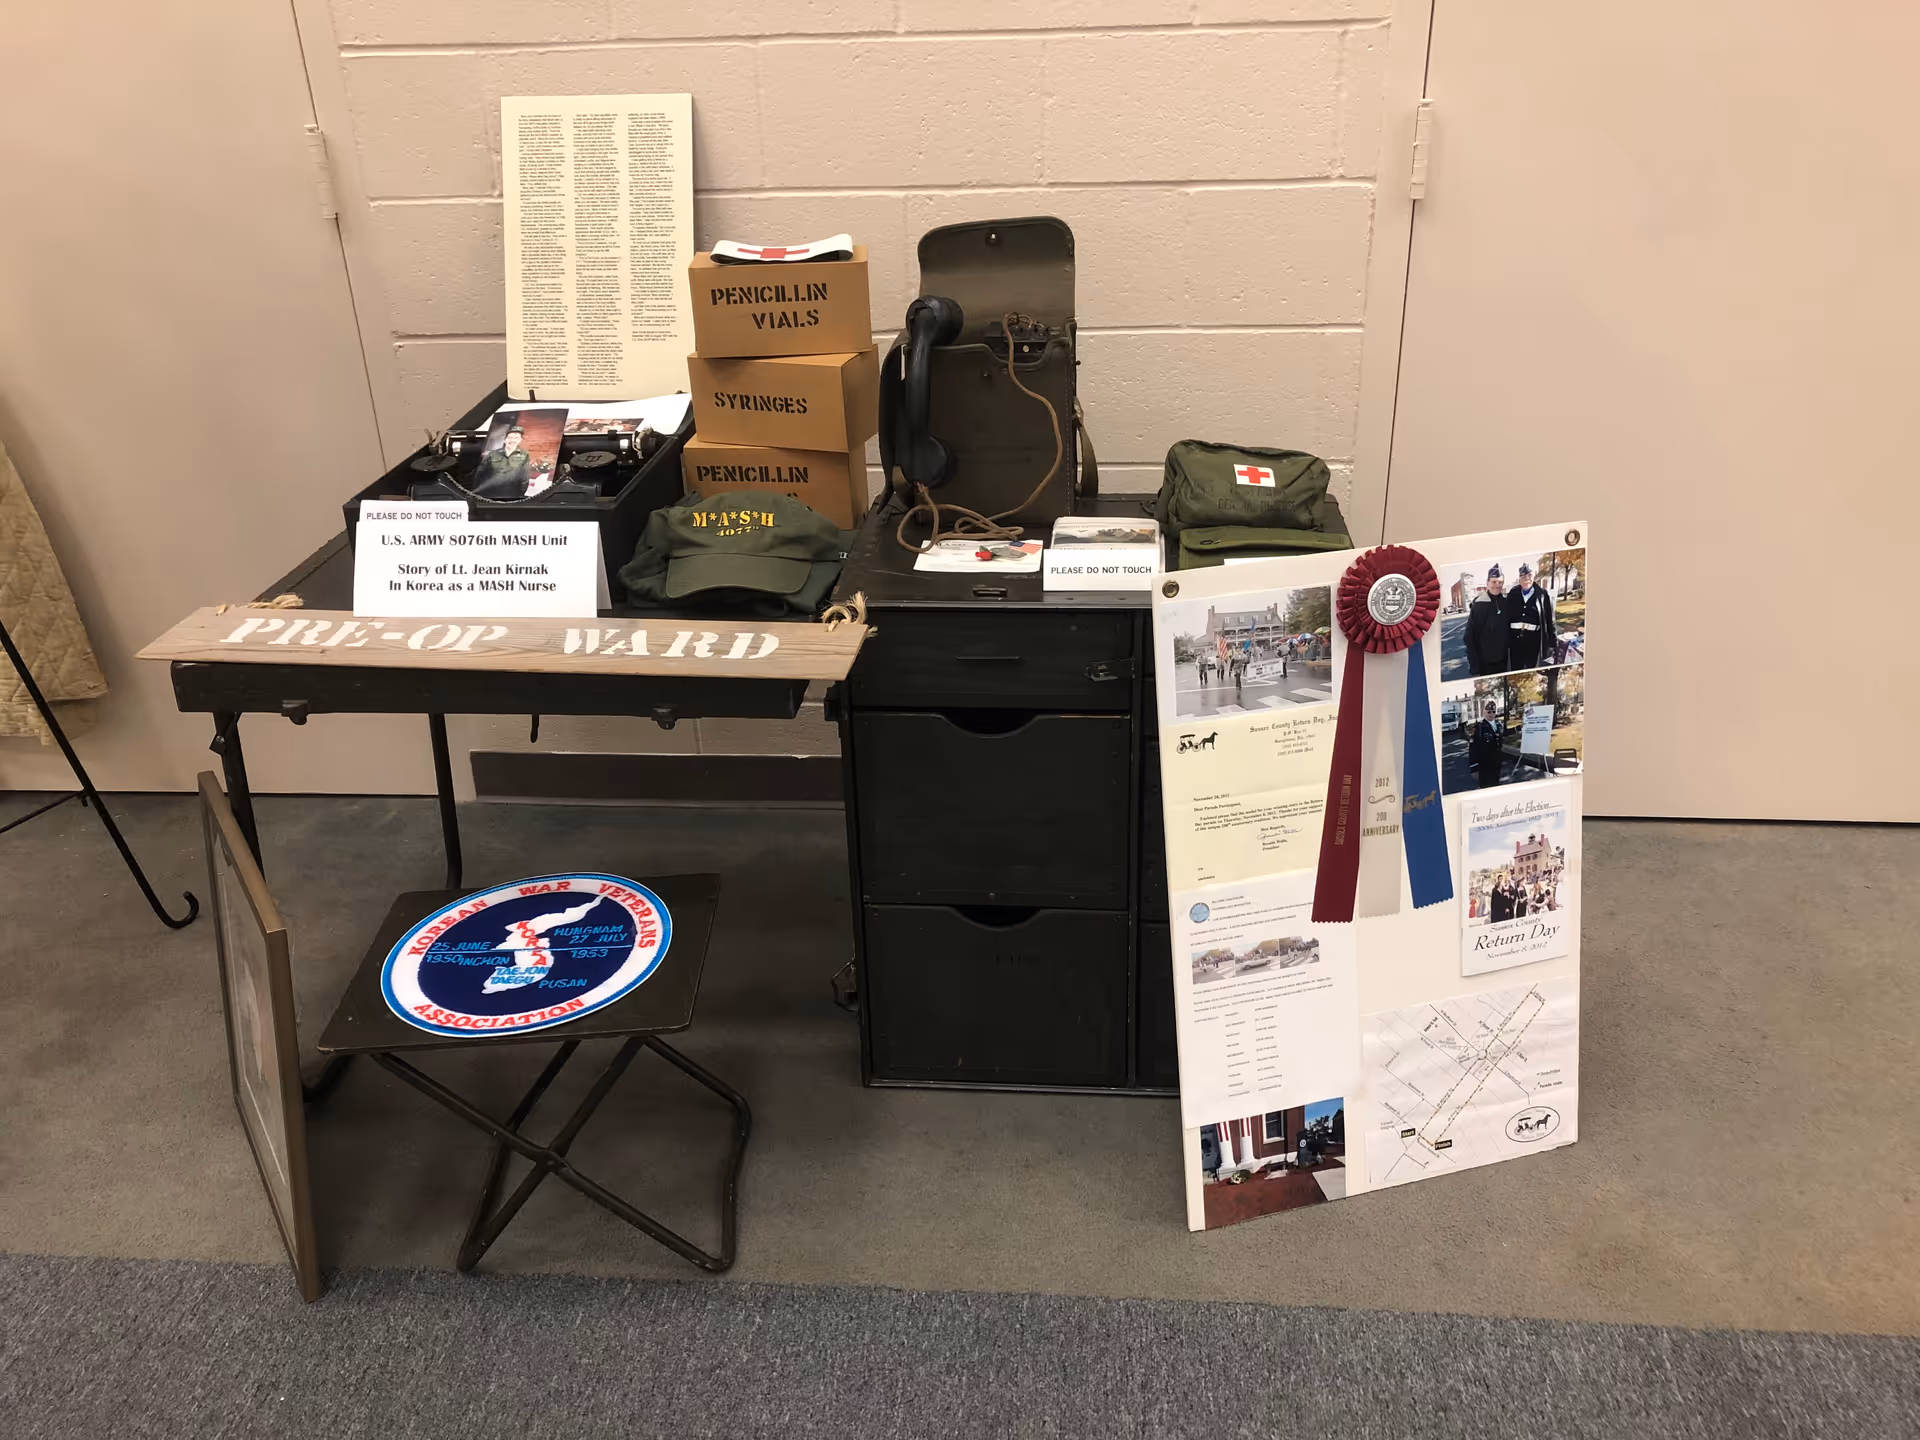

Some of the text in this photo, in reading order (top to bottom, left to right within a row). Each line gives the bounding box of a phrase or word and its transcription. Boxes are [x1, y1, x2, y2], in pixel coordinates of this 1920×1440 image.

[710, 283, 827, 305] PENICILLIN
[751, 309, 820, 329] VIALS
[714, 391, 808, 414] SYRINGES
[696, 465, 809, 483] PENICILLIN
[366, 512, 462, 520] PLEASE DO NOT TOUCH
[381, 534, 568, 546] U.S. ARMY 8076th MASH Unit
[397, 564, 548, 577] Story of Lt. Jean Kirnak
[1051, 567, 1083, 575] PLEASE
[1123, 566, 1152, 574] TOUCH
[389, 580, 556, 591] In Korea as a MASH Nurse
[218, 618, 780, 659] PRE-OP WARD
[1375, 777, 1390, 788] 2012
[1472, 813, 1485, 823] Two
[1486, 808, 1499, 822] days
[1499, 805, 1513, 818] after
[1514, 802, 1524, 815] the
[1362, 825, 1400, 837] ANNIVERSARY
[407, 881, 656, 956] KOREAN WAR VETERANS
[1515, 917, 1542, 927] County
[554, 924, 624, 937] HUNGNAM
[516, 920, 548, 966] KOREA
[570, 932, 627, 944] 27 JULY
[1472, 923, 1561, 951] Return Day
[431, 941, 493, 951] 25 JUNE
[1486, 948, 1520, 960] November
[1529, 941, 1548, 950] 2012
[424, 954, 511, 966] 1950 INCHON
[570, 949, 609, 959] 1953
[494, 965, 550, 976] TAEJON
[489, 975, 535, 985] TAEGU
[538, 978, 589, 989] PUSAN
[413, 998, 585, 1029] ASSOCIATION
